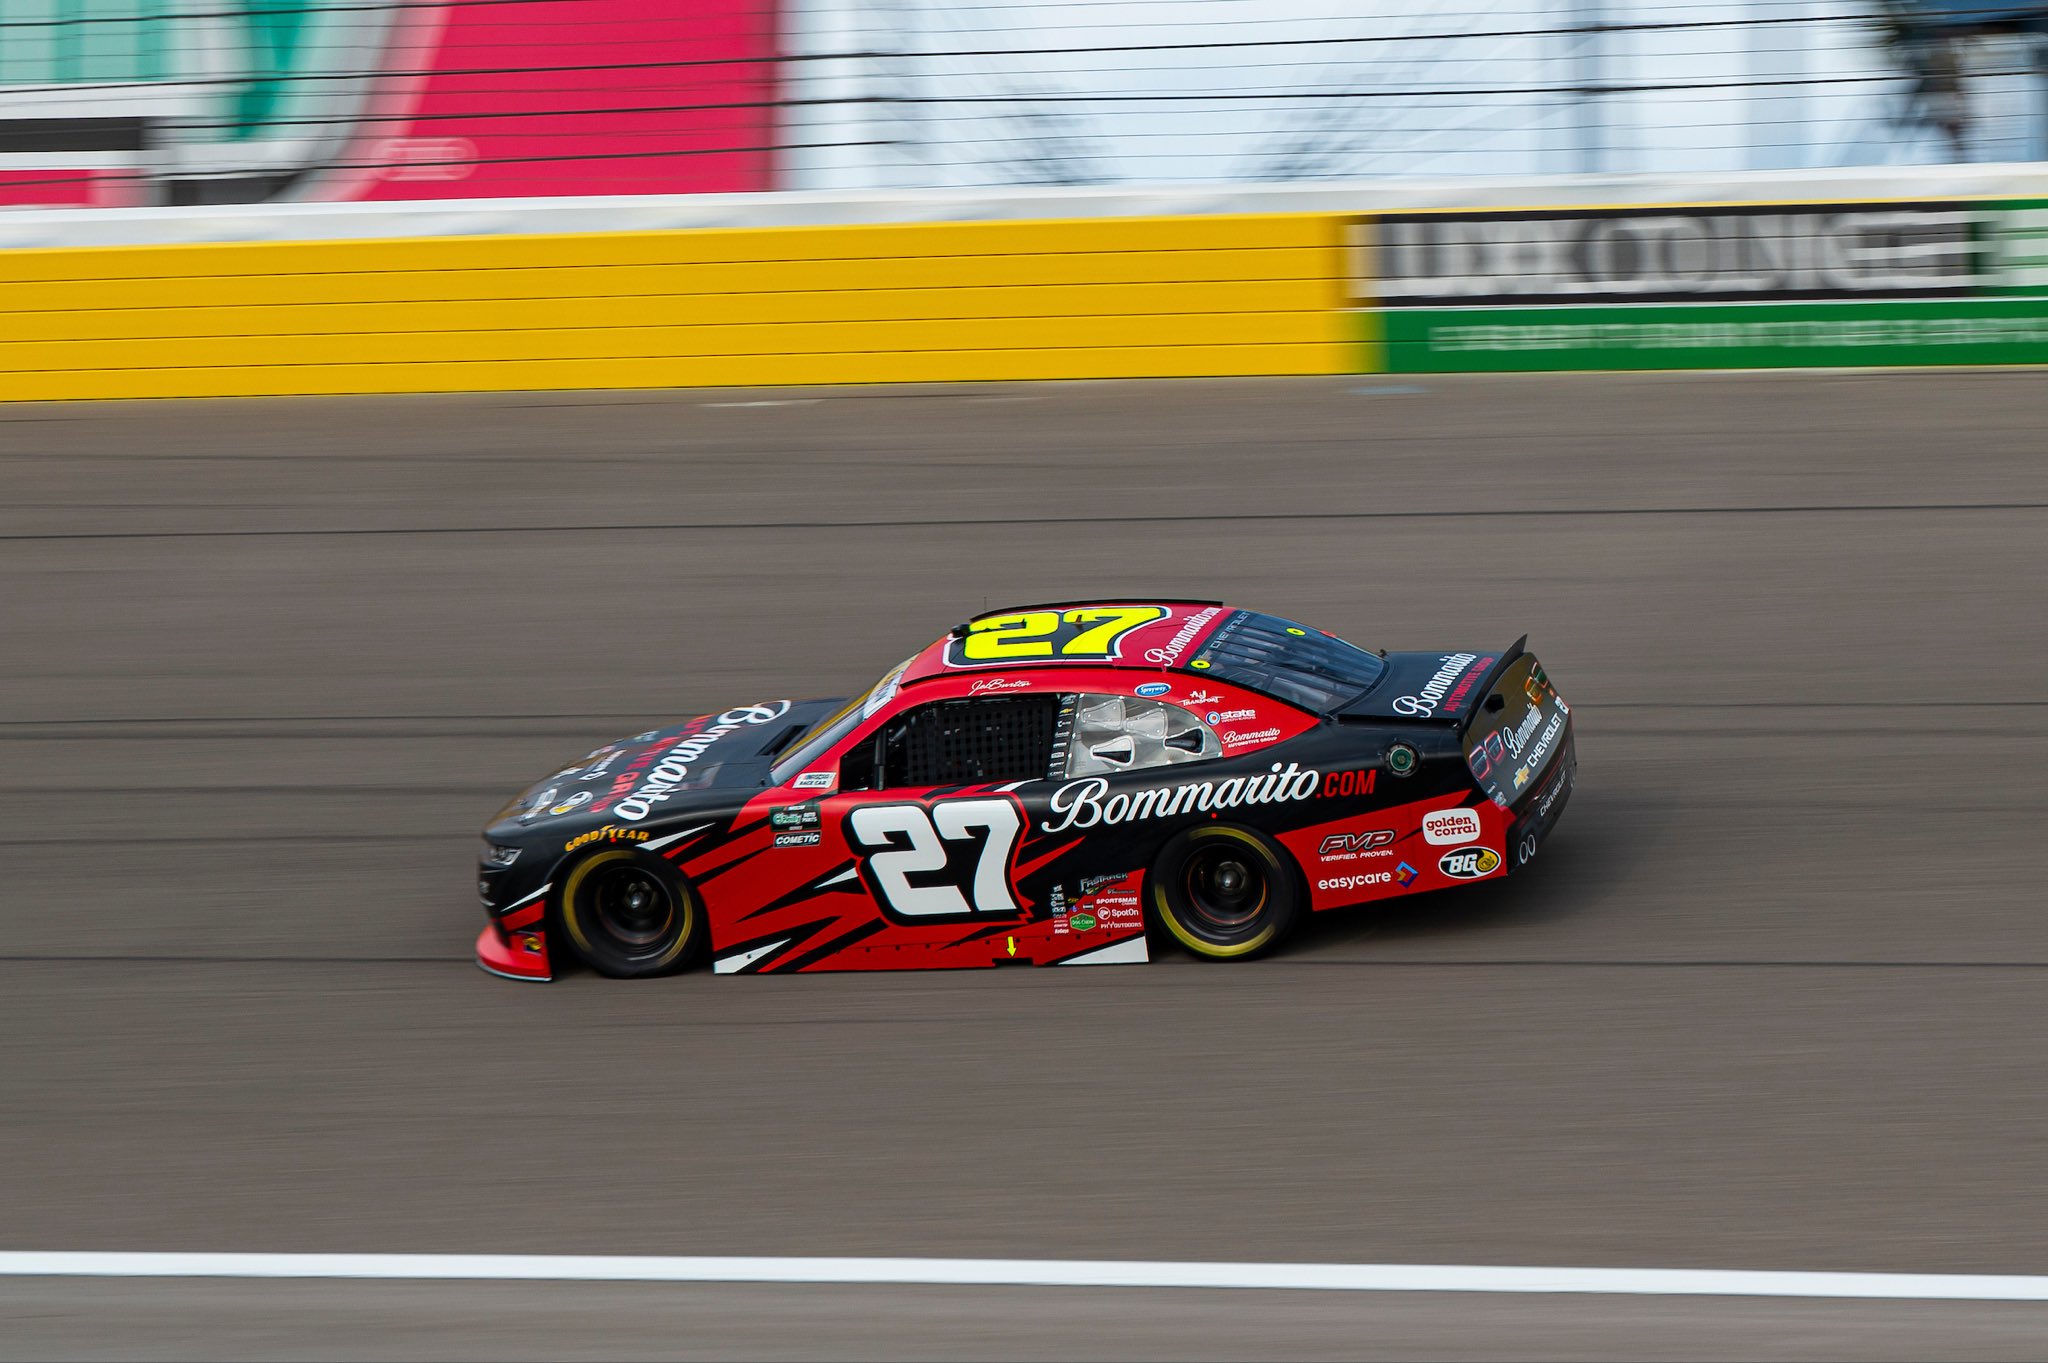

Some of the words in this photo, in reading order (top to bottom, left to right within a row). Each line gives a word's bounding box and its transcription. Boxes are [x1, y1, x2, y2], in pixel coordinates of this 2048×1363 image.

[964, 607, 1161, 660] 27
[1392, 651, 1477, 718] Bommarito
[1219, 708, 1255, 720] state
[1221, 728, 1280, 746] Bommarito
[1526, 712, 1563, 768] CHEVROLET
[1540, 772, 1566, 816] CHEVROLET
[1425, 816, 1472, 832] golden
[1434, 823, 1478, 837] corral
[565, 825, 650, 851] GOODYEAR
[1318, 830, 1395, 853] FVP
[851, 799, 1020, 916] 27
[1320, 853, 1358, 862] VERIFIED.
[1360, 850, 1394, 859] PROVEN.
[1449, 854, 1478, 874] BG
[1318, 871, 1392, 890] easycare
[1096, 896, 1138, 905] SPORTSMAN
[1111, 908, 1139, 918] SpotOn
